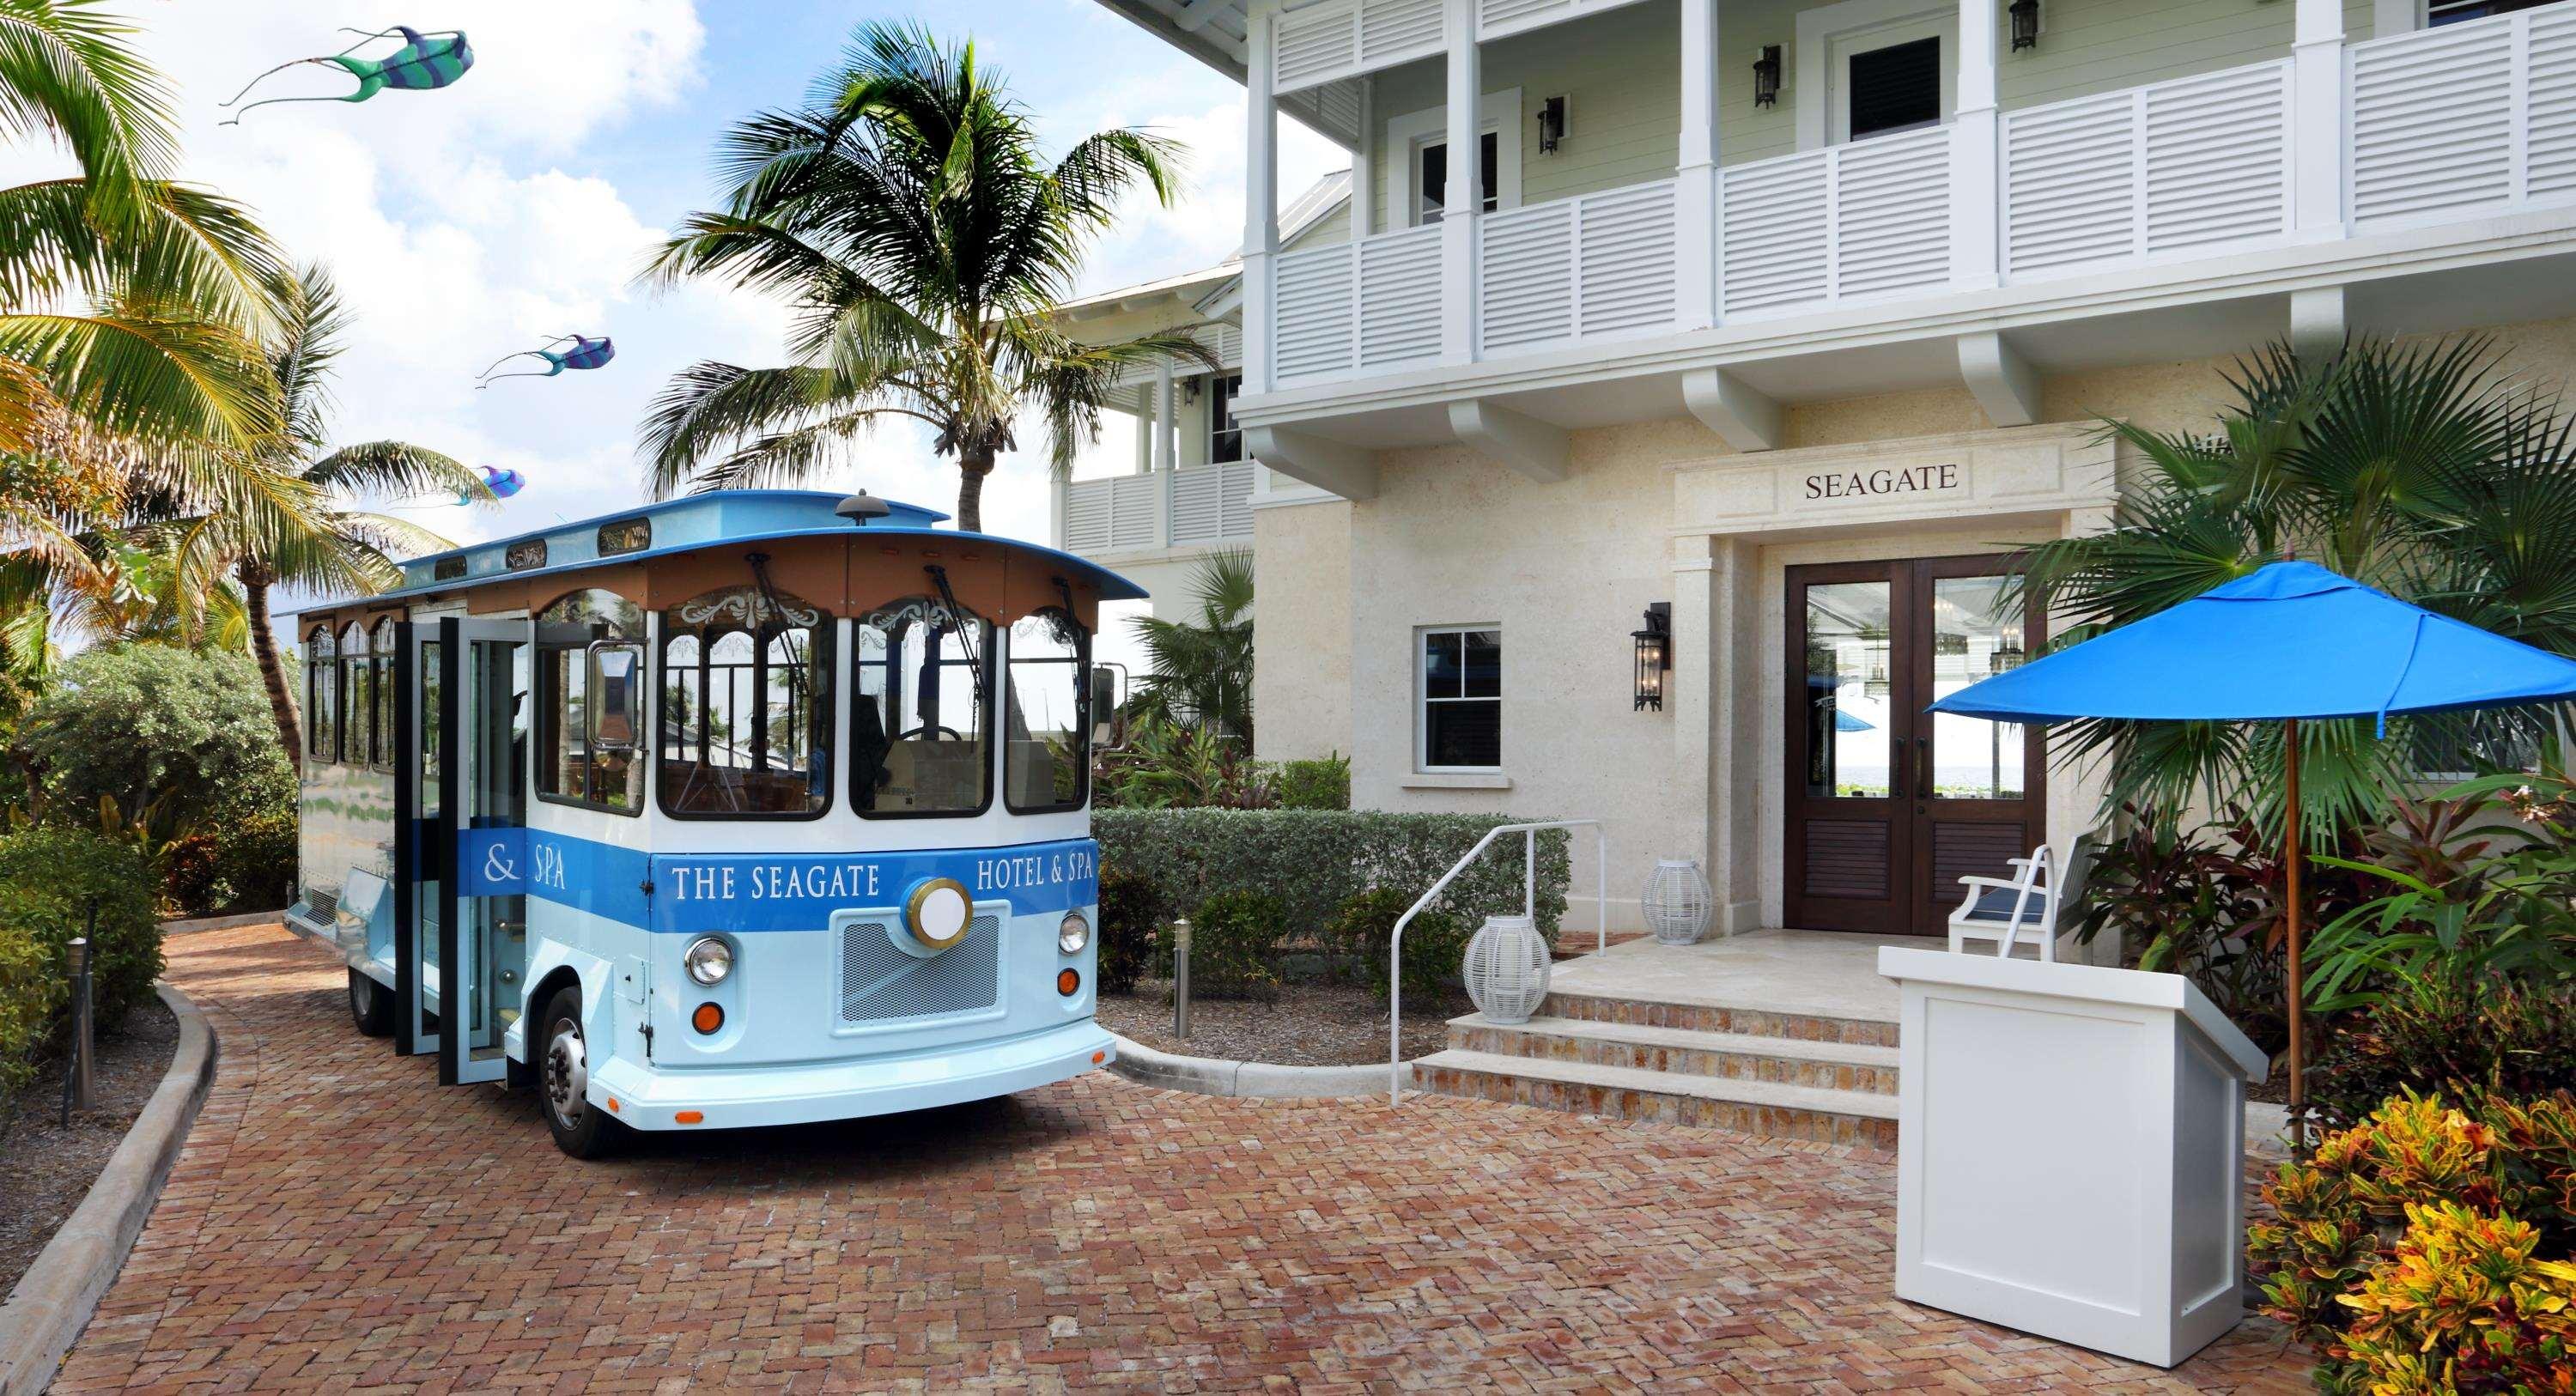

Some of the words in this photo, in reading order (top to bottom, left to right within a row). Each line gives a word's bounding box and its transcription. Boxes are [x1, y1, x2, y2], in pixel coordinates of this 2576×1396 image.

[1806, 464, 1958, 500] SEAGATE
[484, 843, 521, 882] &
[535, 844, 566, 889] SPA
[672, 867, 735, 900] THE
[751, 865, 879, 899] SEAGATE
[977, 857, 1044, 890] HOTEL
[1051, 854, 1063, 883] &
[1068, 852, 1093, 881] SPA
